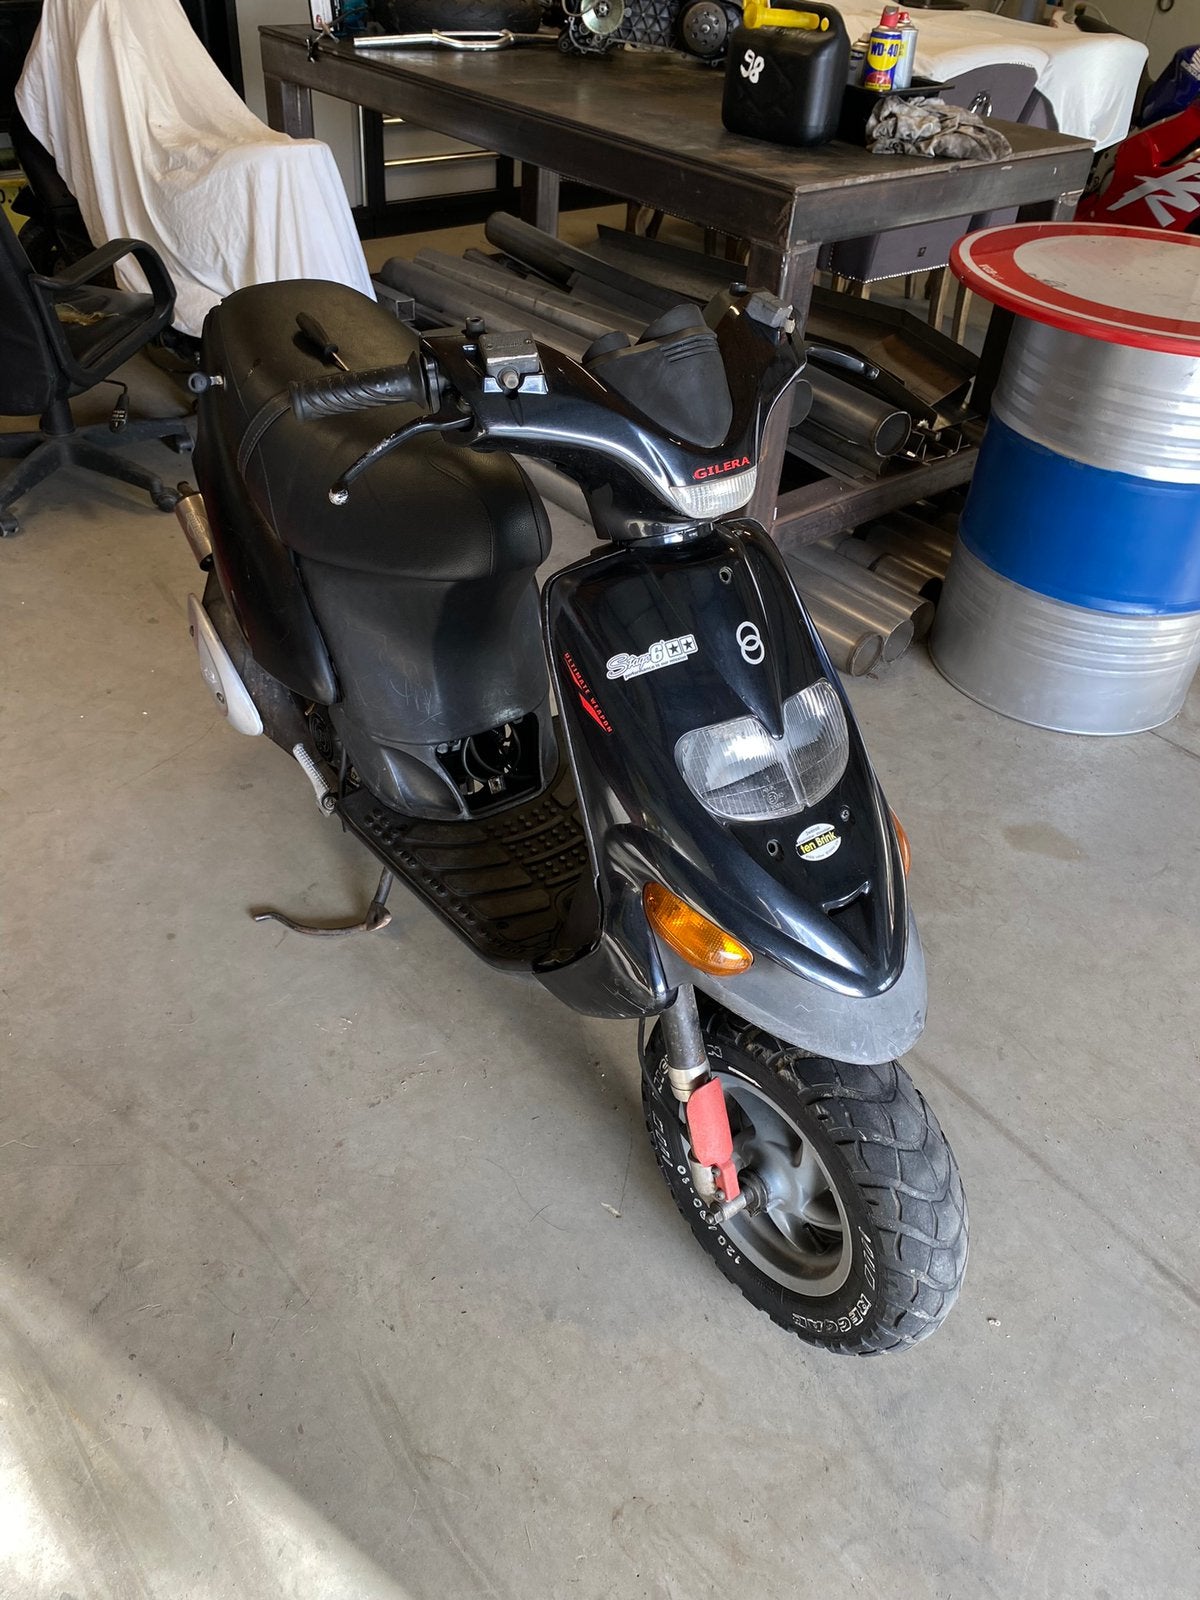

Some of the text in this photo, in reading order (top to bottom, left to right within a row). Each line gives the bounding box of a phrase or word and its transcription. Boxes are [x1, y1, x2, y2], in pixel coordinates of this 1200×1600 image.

[871, 41, 899, 57] WD-40
[740, 49, 765, 84] 98
[693, 456, 750, 480] GILERA
[564, 652, 613, 733] ULTIMATE WEAPON
[800, 842, 817, 854] ten
[815, 831, 837, 847] Brink
